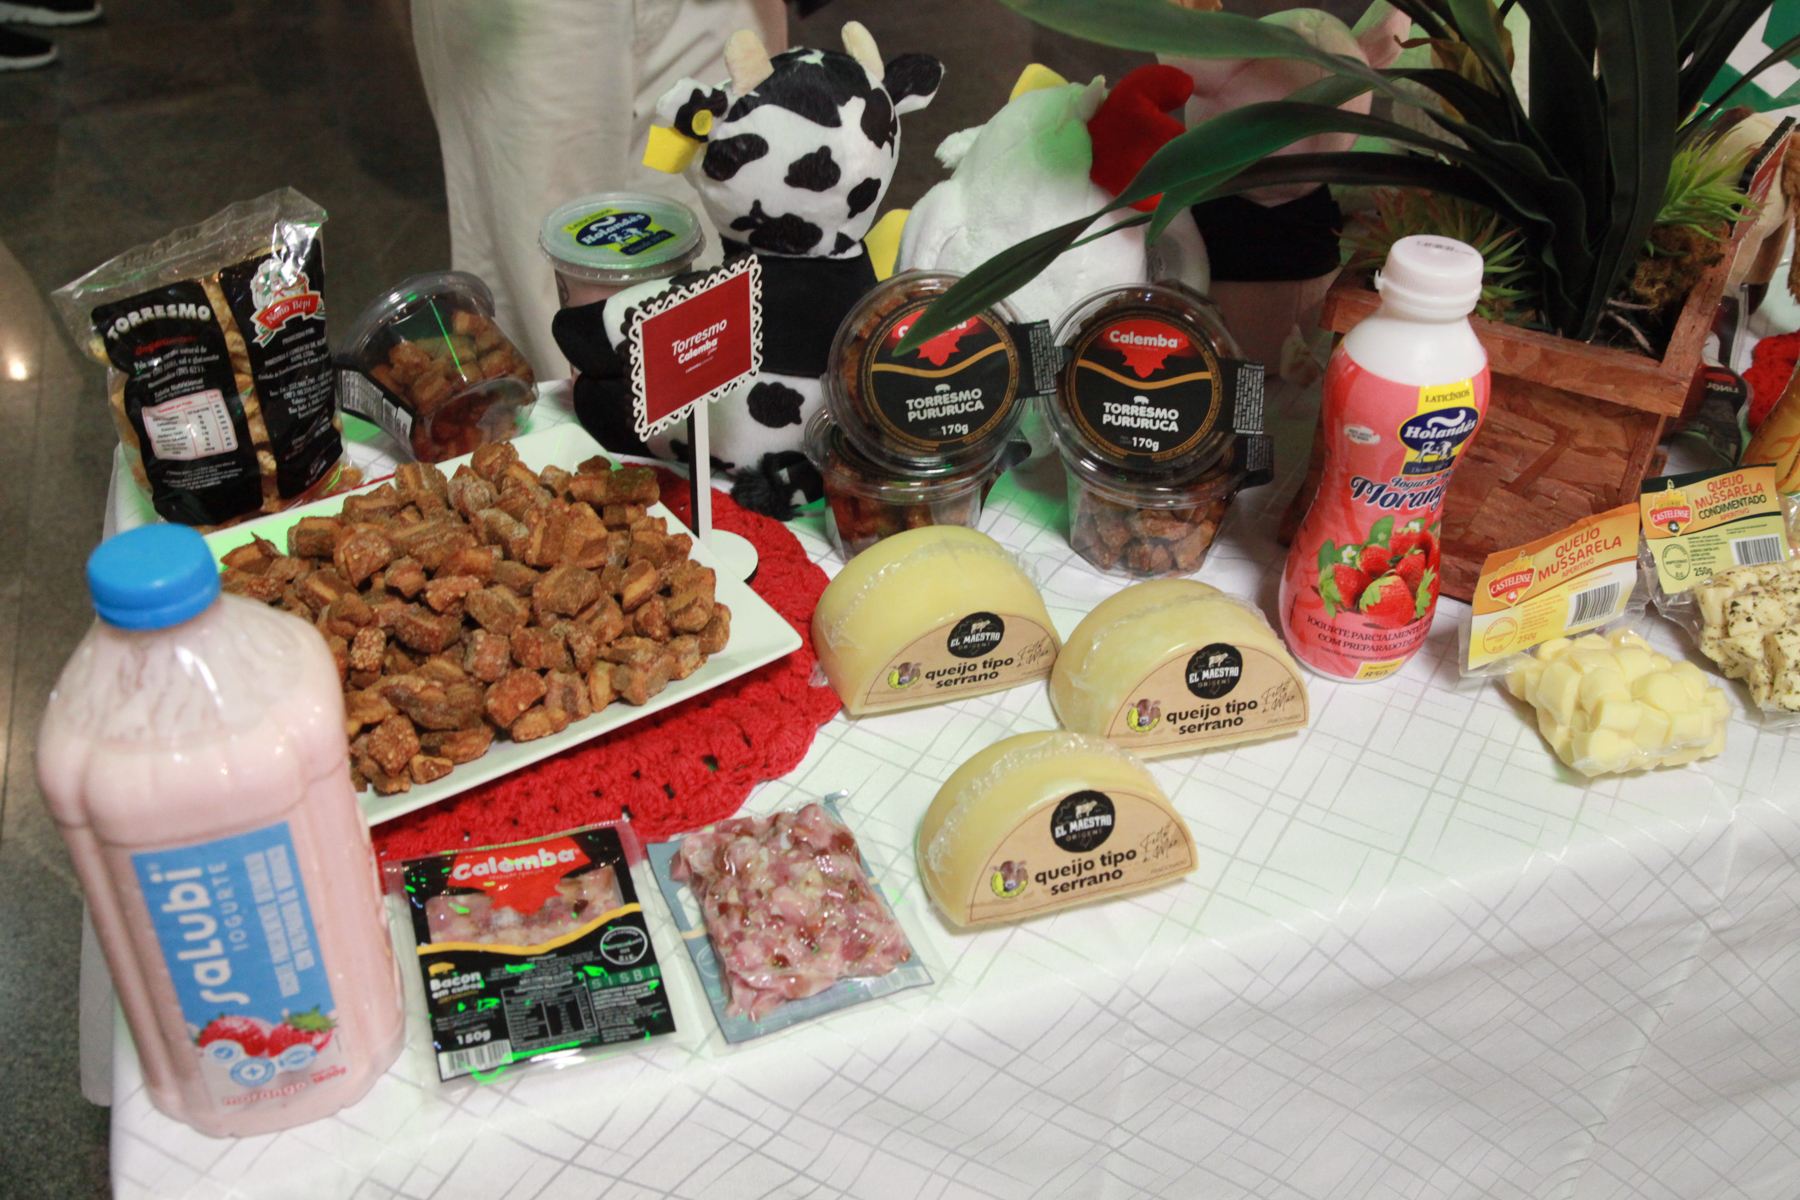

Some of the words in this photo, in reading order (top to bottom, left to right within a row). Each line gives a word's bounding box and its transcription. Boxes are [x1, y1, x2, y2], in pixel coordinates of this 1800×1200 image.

[107, 303, 211, 340] TORRESMO
[672, 319, 727, 356] Torresmo
[1109, 330, 1178, 348] Calemba
[678, 338, 718, 364] Calemba
[906, 388, 982, 411] TORRESMO
[1425, 389, 1470, 403] LATICÍNIOS
[907, 400, 984, 422] PURURUCA
[1103, 402, 1179, 421] TORRESMO
[941, 423, 968, 435] 170g
[1102, 414, 1179, 432] PURURUCA
[1404, 419, 1477, 439] Holandês
[1132, 437, 1159, 452] 170g
[1391, 475, 1438, 491] Iogurte
[1707, 474, 1744, 490] QUEIJO
[1694, 482, 1763, 509] MUSSARELA
[1652, 510, 1690, 522] CASTELENSE
[1699, 494, 1767, 520] CONDIMENTADO
[1720, 508, 1750, 521] APERITIVO
[1555, 527, 1600, 558] QUEIJO
[1538, 536, 1622, 582] MUSSARELA
[1561, 558, 1595, 578] APERITIVO
[1694, 567, 1713, 577] 250g
[1490, 572, 1533, 595] CASTELENSE
[1307, 615, 1350, 637] IOGURTE
[1351, 627, 1420, 641] PARCIALMENTE
[1517, 632, 1537, 644] 250g
[950, 638, 960, 647] EL
[962, 632, 1000, 644] MAESTRO
[1318, 633, 1341, 646] COM
[1343, 641, 1401, 652] PREPARADO
[925, 662, 977, 680] queijo
[982, 657, 1014, 670] tipo
[1189, 673, 1199, 684] EL
[1202, 666, 1239, 680] MAESTRO
[936, 671, 999, 688] serrano
[1166, 704, 1220, 724] queijo
[1225, 700, 1258, 715] tipo
[1179, 716, 1243, 735] serrano
[1055, 826, 1067, 838] EL
[1069, 814, 1112, 833] MAESTRO
[453, 848, 576, 880] Calemba
[1035, 859, 1094, 885] queijo
[1100, 849, 1137, 868] tipo
[1050, 869, 1123, 895] serrano
[208, 861, 249, 951] IOGURTE
[430, 972, 482, 992] Bacon
[591, 967, 655, 990] SISBI
[432, 989, 449, 999] em
[456, 1029, 491, 1045] 150g
